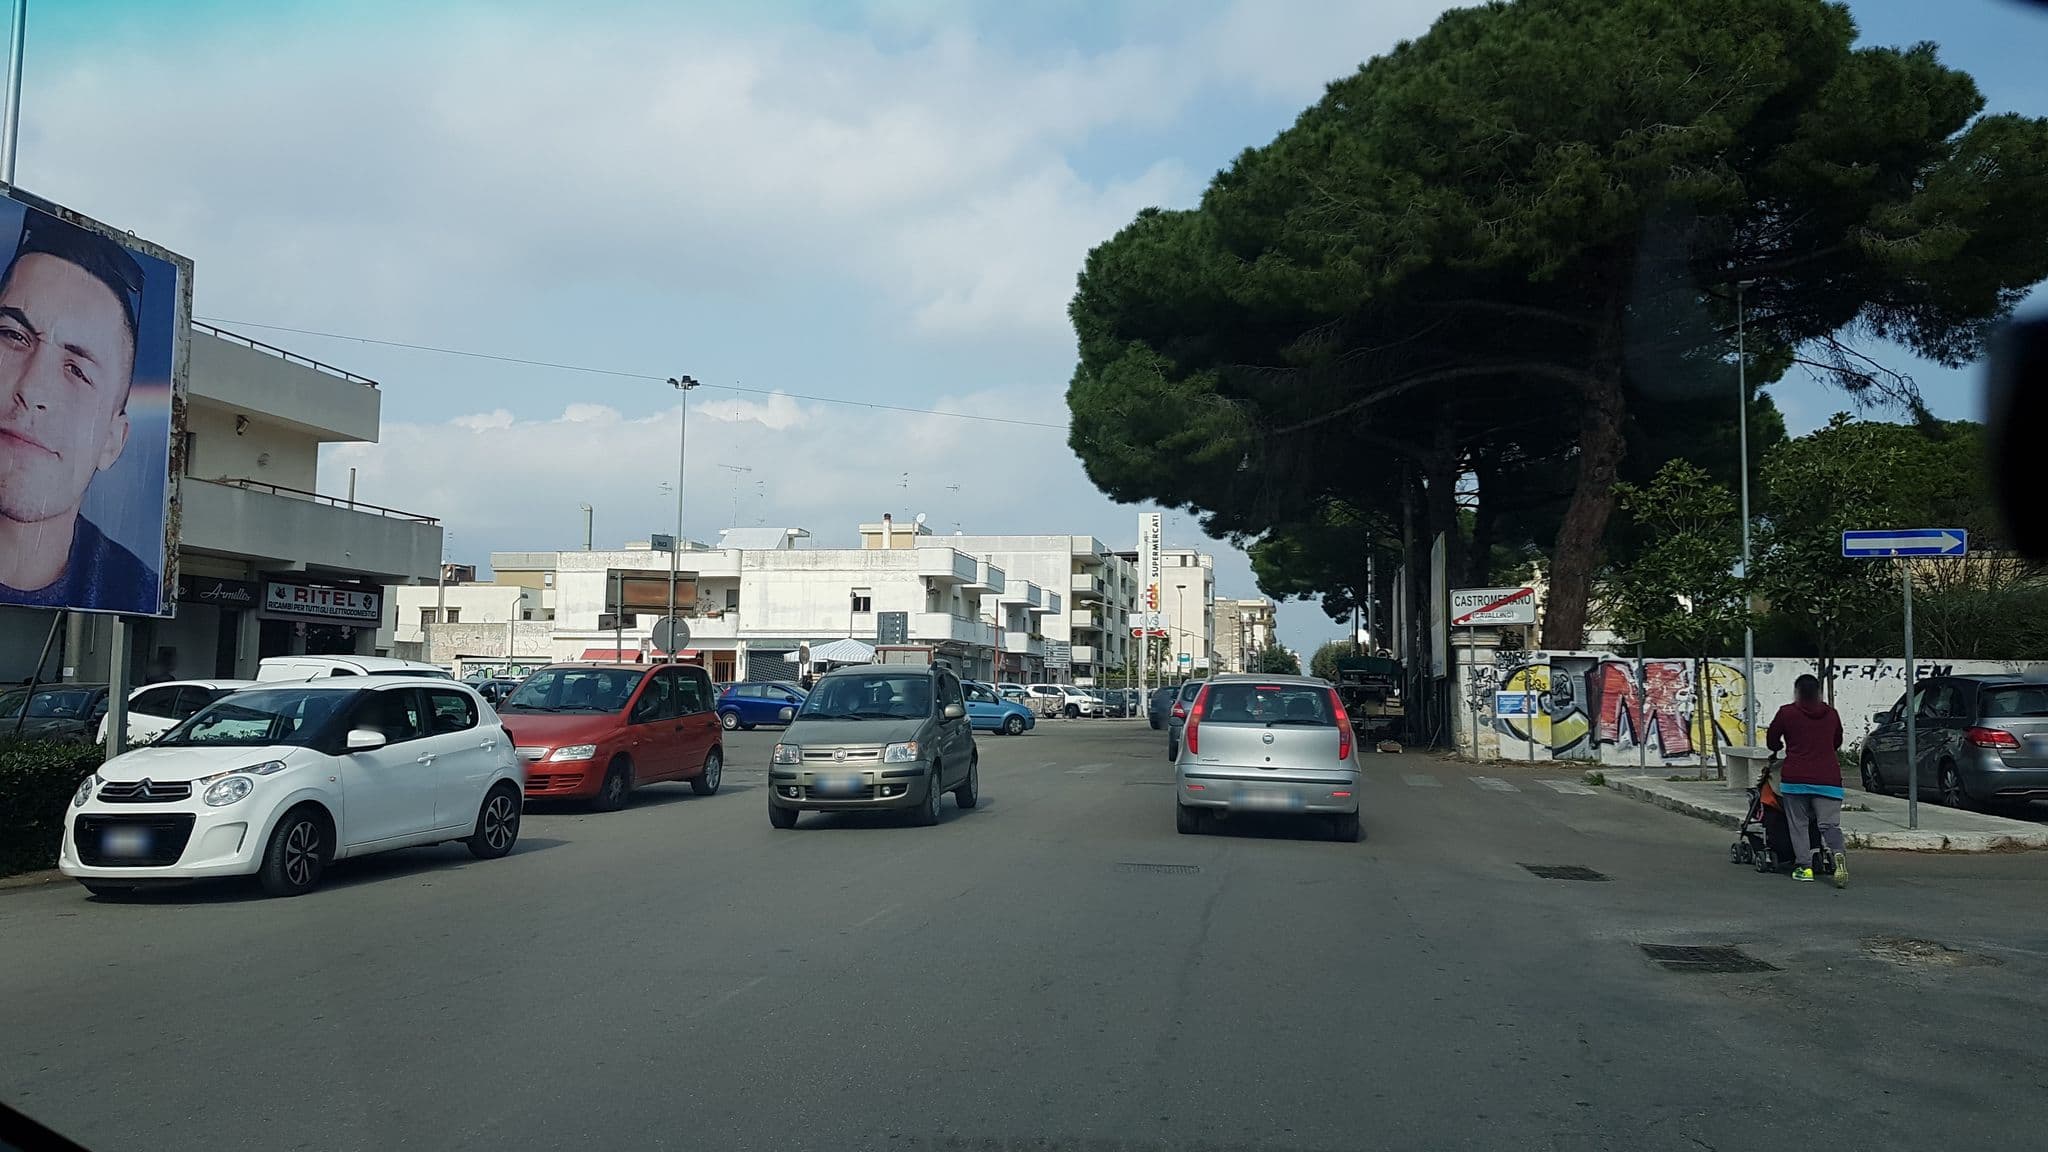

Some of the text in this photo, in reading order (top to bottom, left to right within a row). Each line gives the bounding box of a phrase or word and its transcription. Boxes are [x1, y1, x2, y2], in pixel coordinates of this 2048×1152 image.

[295, 588, 355, 607] RITEL
[268, 602, 293, 610] RICAMBI
[329, 608, 376, 617] ELETTRODOMESTICI
